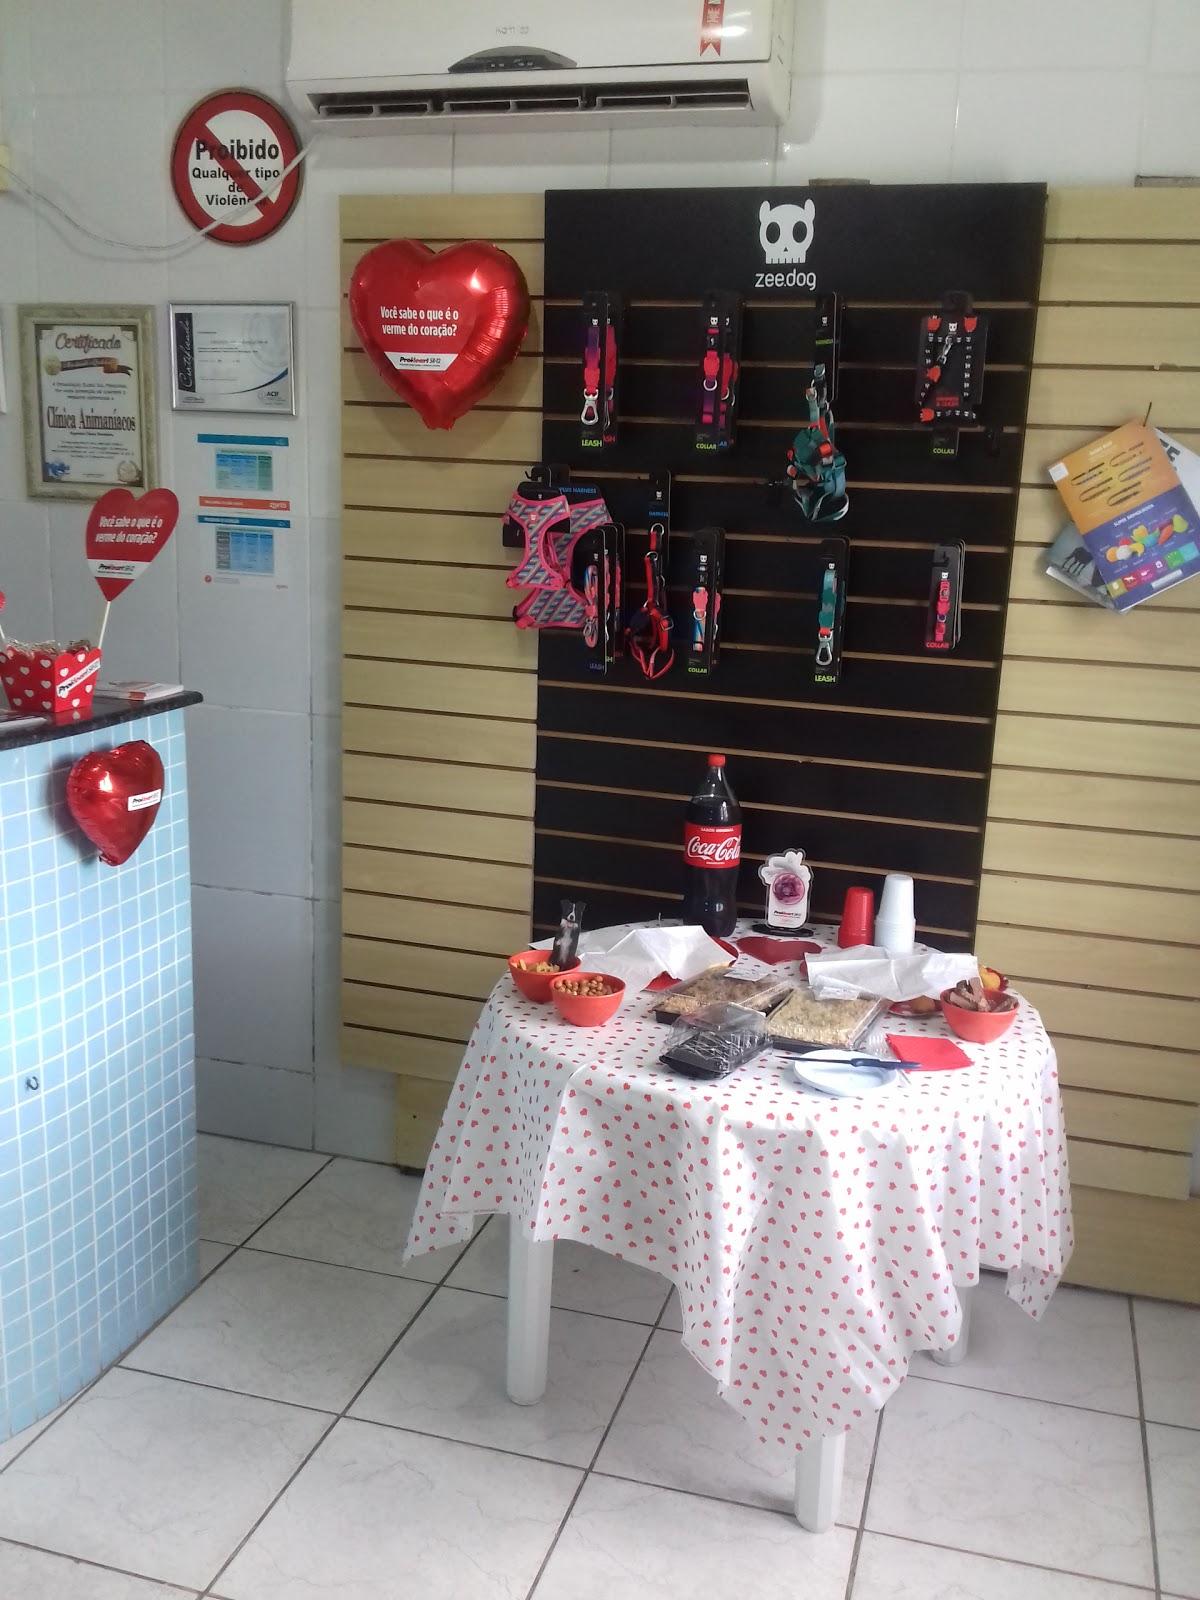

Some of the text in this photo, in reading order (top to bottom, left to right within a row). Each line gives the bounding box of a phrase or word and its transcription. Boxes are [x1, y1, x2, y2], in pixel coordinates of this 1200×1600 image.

[195, 139, 280, 161] Proibido
[192, 167, 280, 181] Qualqr tipo
[755, 269, 817, 291] zee.dog
[380, 305, 459, 322] Você sabe o que é o
[382, 323, 457, 338] verme do coração?
[581, 439, 603, 448] LEASH
[814, 675, 836, 683] LEASH
[687, 836, 741, 861] Coca-Cola
